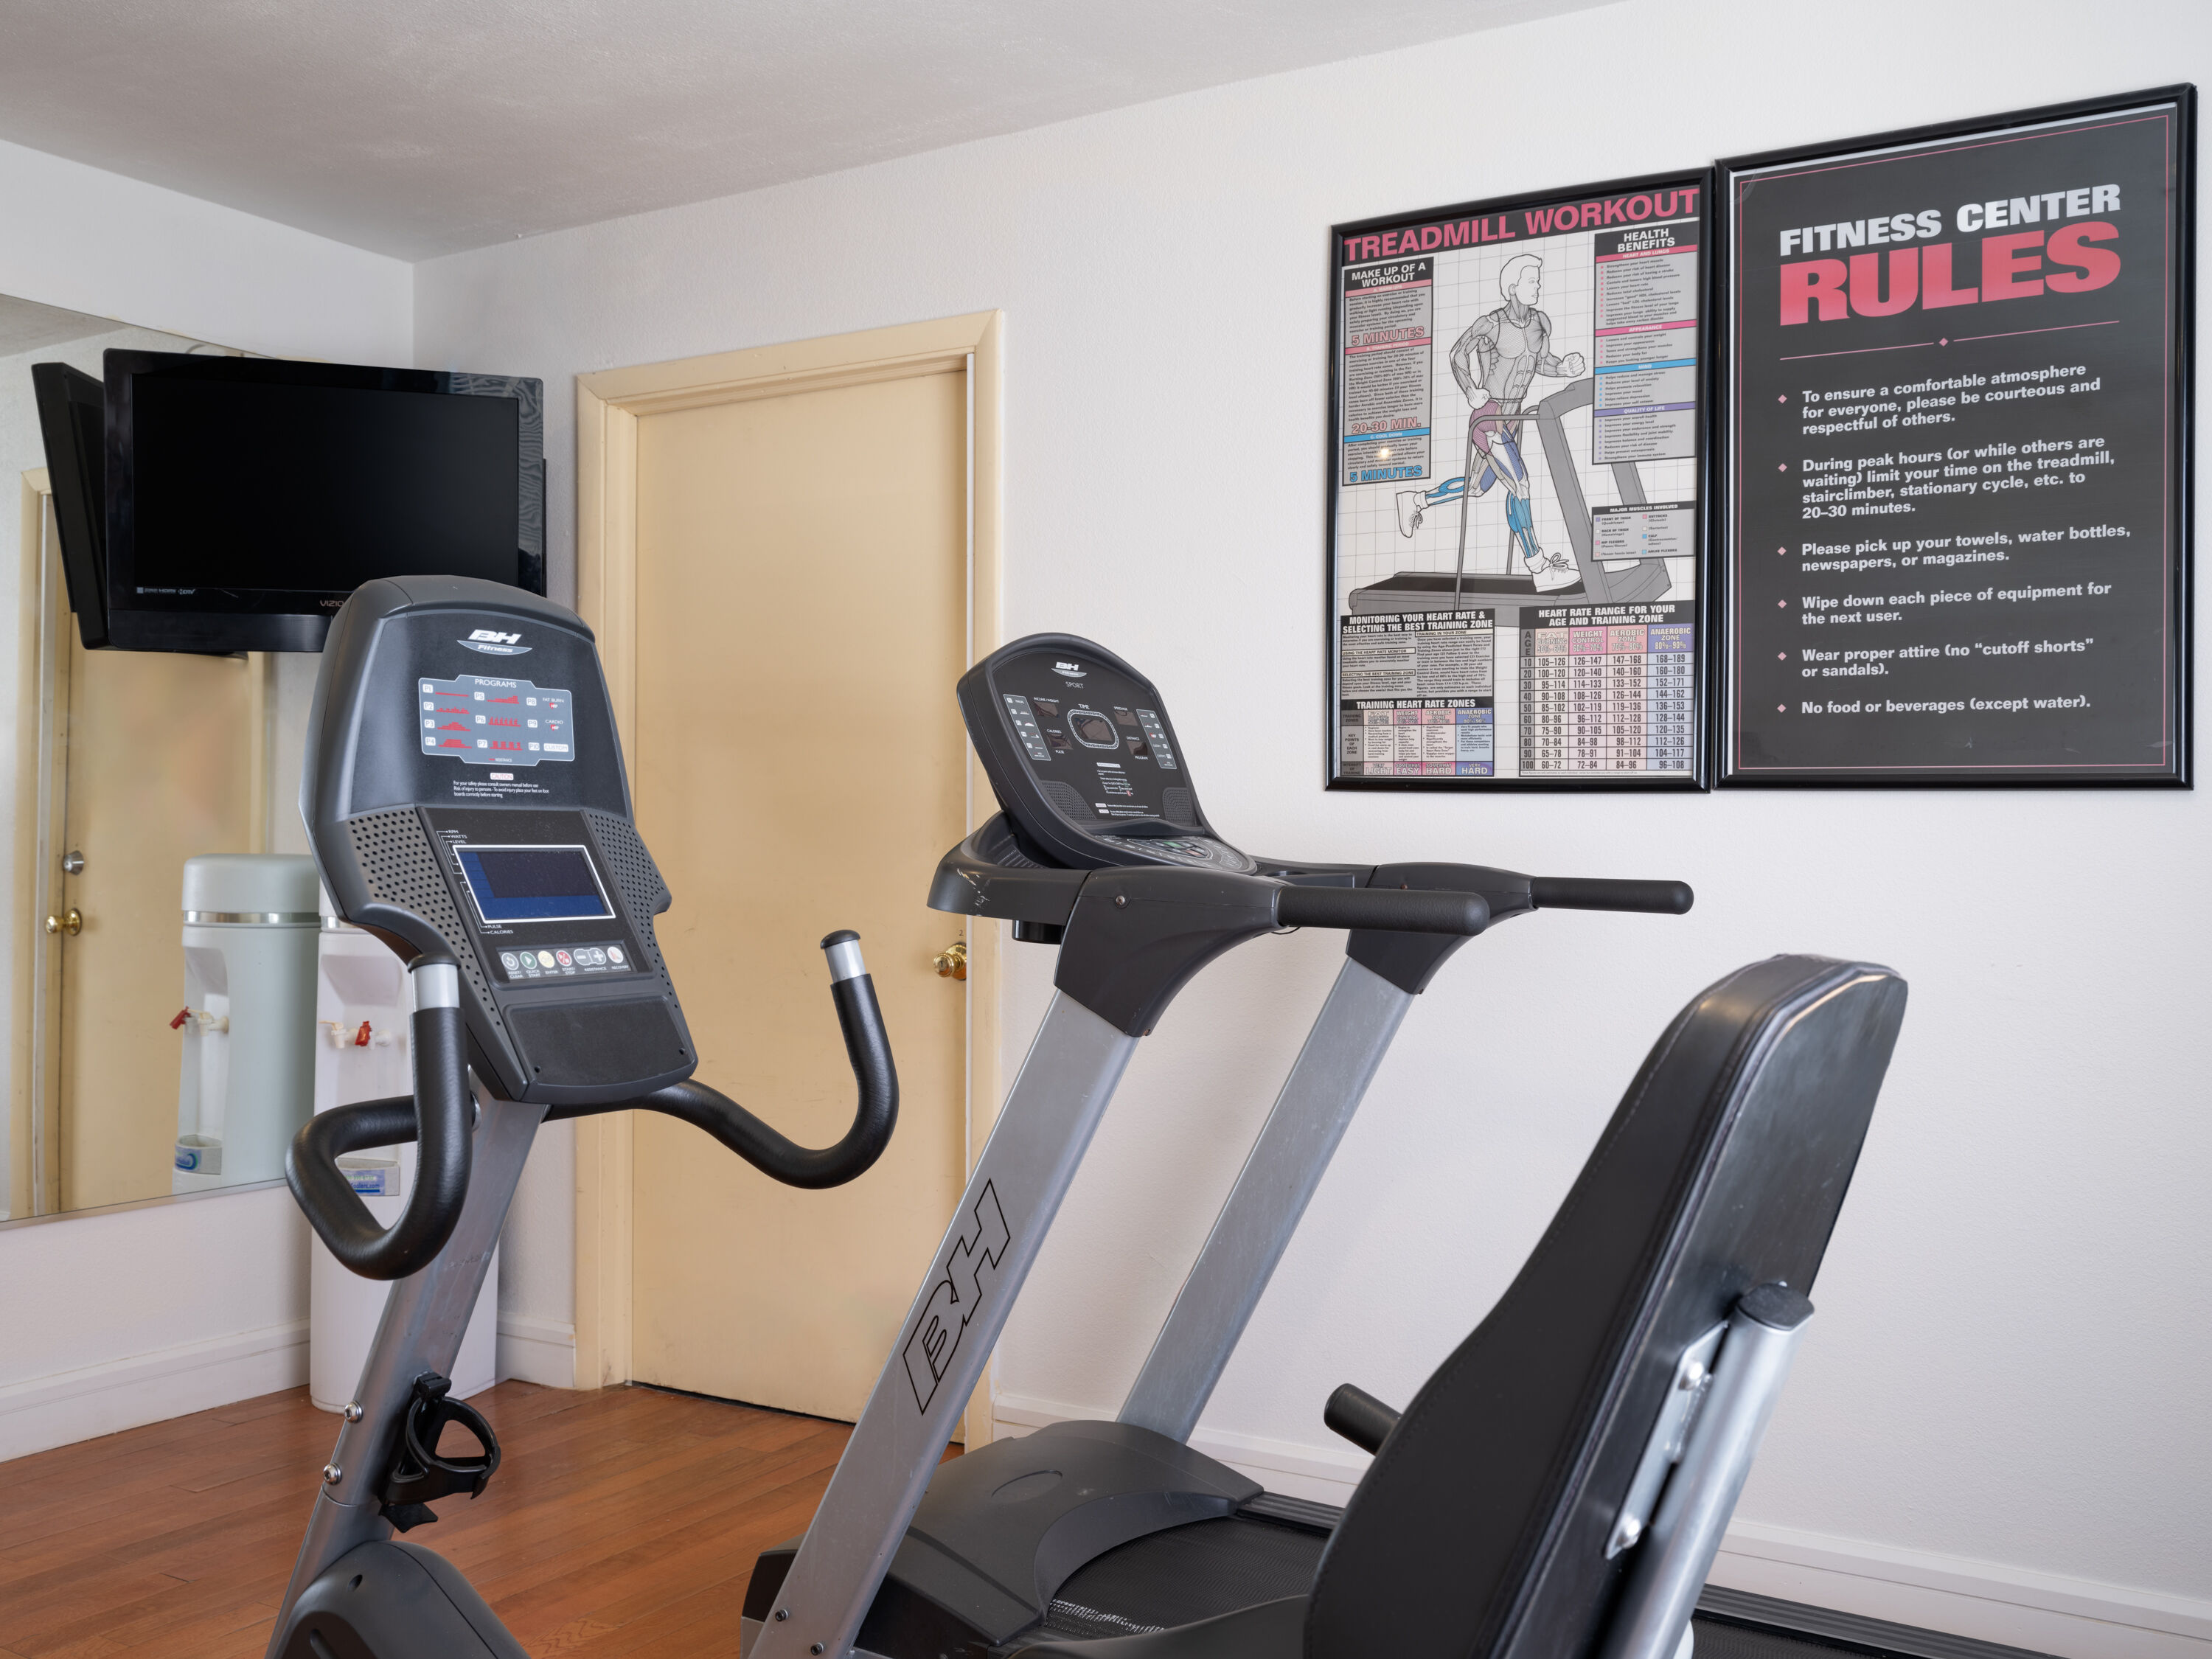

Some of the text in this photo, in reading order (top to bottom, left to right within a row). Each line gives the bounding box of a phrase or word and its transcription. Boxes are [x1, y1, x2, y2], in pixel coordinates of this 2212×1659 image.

[1344, 189, 1699, 260] TREADMILL WORKOUT
[1780, 184, 2120, 256] FITNESS CENTER
[1624, 228, 1668, 242] HEALTH
[1618, 237, 1674, 252] BENEFITS
[1352, 262, 1425, 280] MAKE UP OF A
[1362, 272, 1414, 287] WORKOUT
[1780, 221, 2121, 326] RULES
[1352, 326, 1425, 345] 5 MINUTES
[1802, 365, 2086, 402] To ensure a comfortable atmosphere
[1802, 378, 2100, 418] for everyone, please be courteous and
[1352, 417, 1421, 434] 20-30 MIN.
[1803, 412, 1955, 436] respectful of others.
[1803, 438, 2104, 471] During peak hours (or while others are
[1350, 465, 1422, 482] 5 MINUTES
[1803, 451, 2114, 487] waiting) limit your time on the treadmill,
[1803, 472, 2085, 503] stairclimber, stationary cycle, etc. to
[1852, 502, 1915, 515] minutes.
[1802, 524, 2129, 555] Please pick up your towels, water bottles,
[1802, 549, 2008, 572] newspapers, or magazines.
[1802, 582, 2111, 611] Wipe down each piece of equipment for
[1349, 614, 1399, 624] MONITORING
[1402, 613, 1423, 622] YOUR
[1427, 612, 1453, 621] HEART
[1455, 611, 1475, 619] RATE
[1539, 605, 1674, 617] HEART RATE RANGE FOR YOUR
[1802, 611, 1902, 625] the next user.
[1343, 619, 1492, 633] SELECTING THE BEST TRAINING ZONE
[1549, 614, 1663, 626] AGE AND TRAINING ZONE
[467, 629, 521, 644] BH
[1802, 649, 1840, 661] Wear
[1844, 650, 1894, 662] proper
[1899, 645, 1939, 658] attire
[1945, 644, 1969, 655] (no
[1056, 662, 1079, 671] BH
[1524, 658, 1531, 667] 10
[1802, 663, 1888, 677] or sandals).
[475, 678, 516, 688] PROGRAMS
[1357, 699, 1475, 709] TRAINING HEART RATE ZONES
[1802, 695, 2090, 714] No food or beverages (except water).
[1523, 761, 1533, 769] 100
